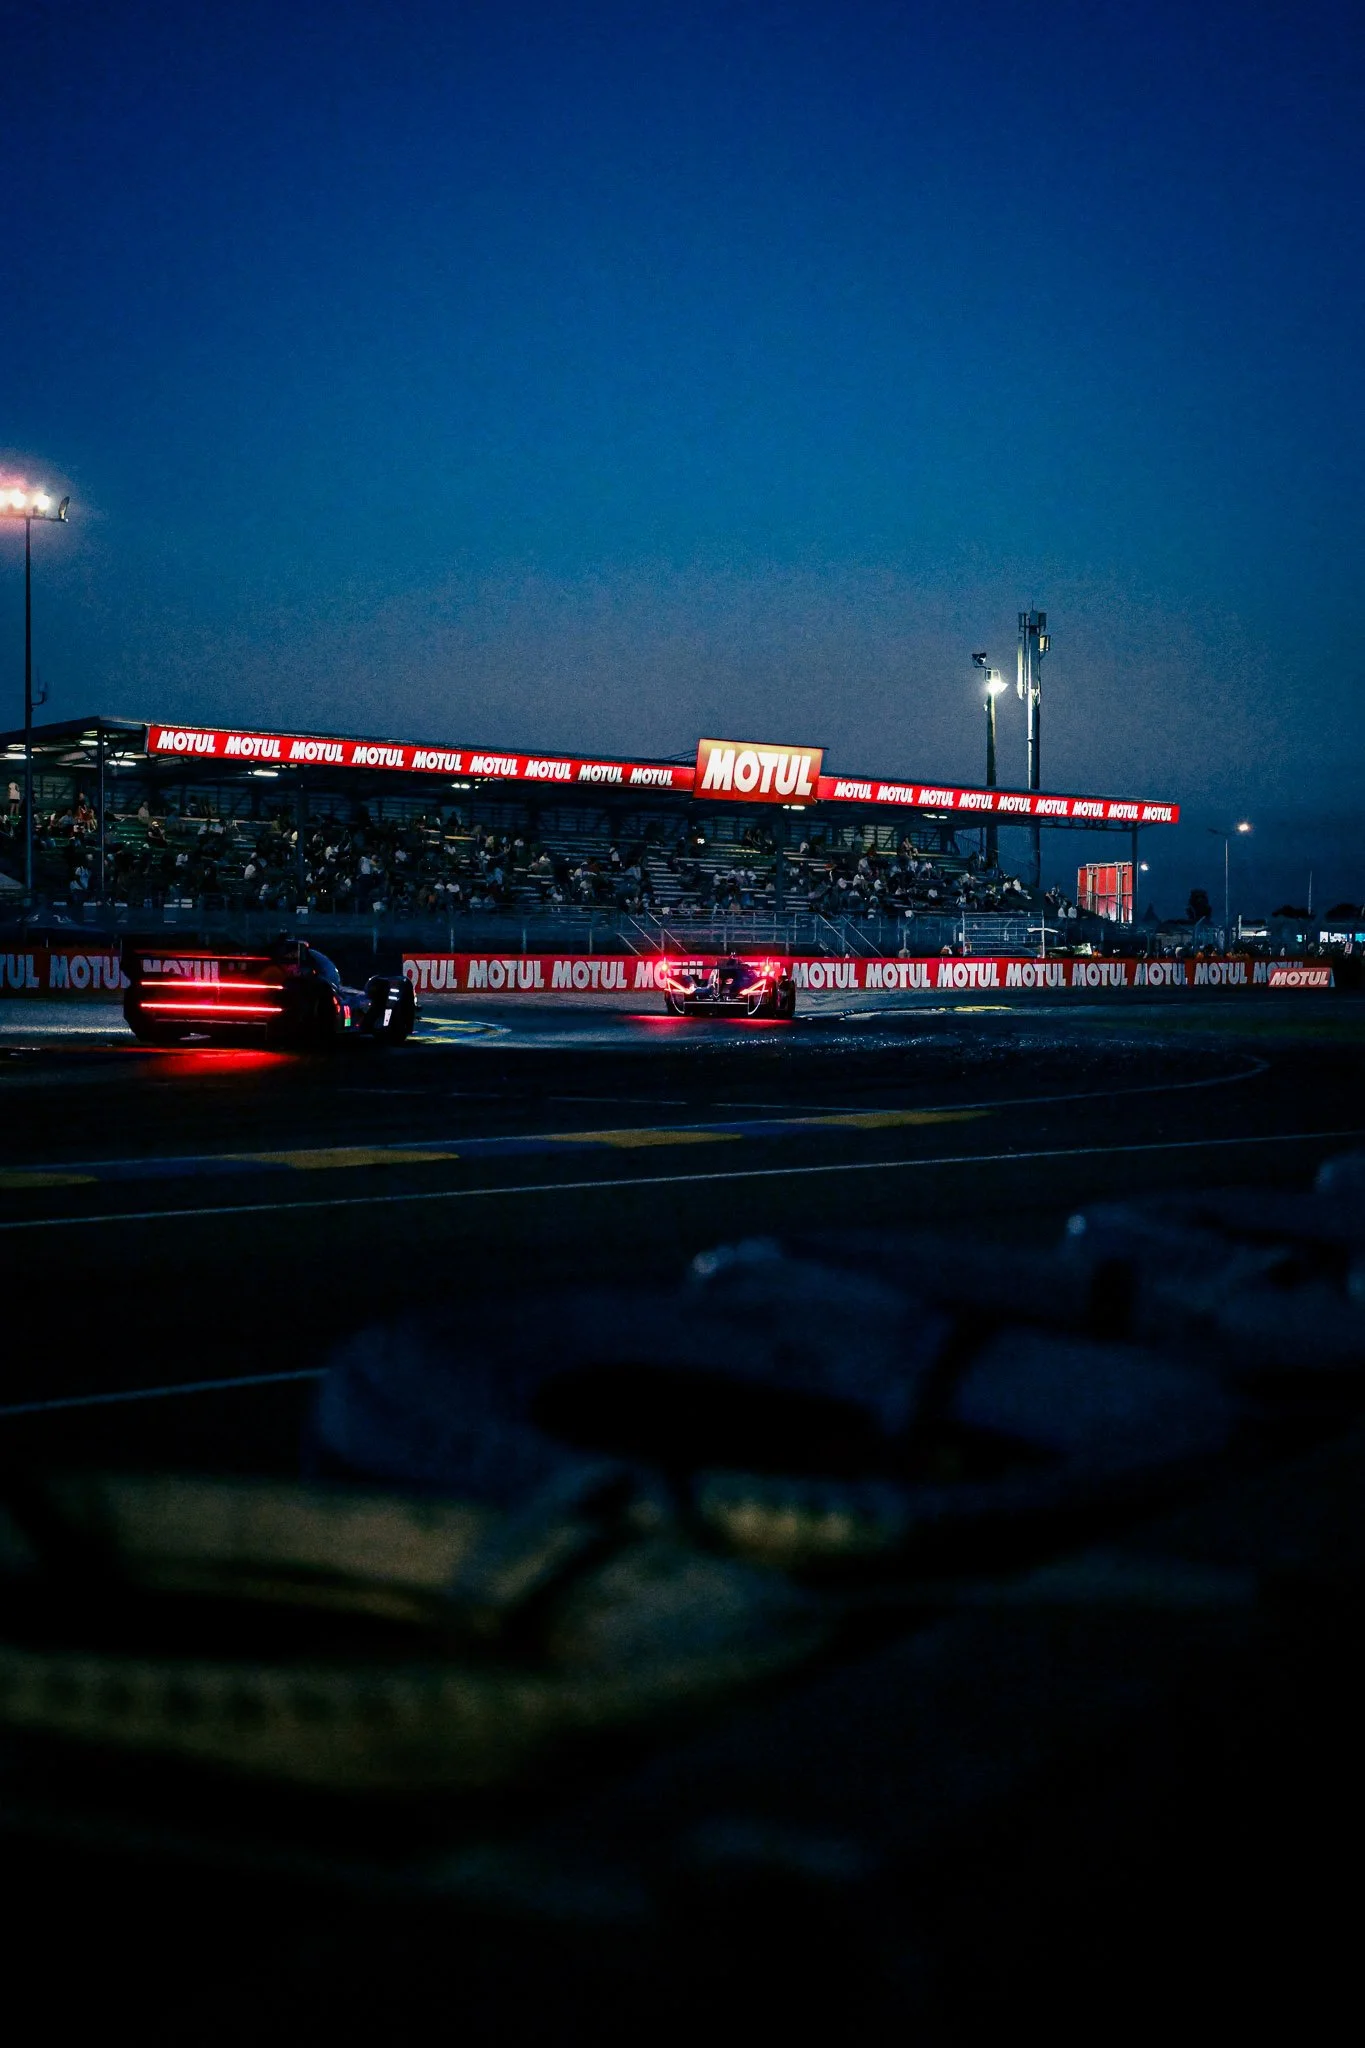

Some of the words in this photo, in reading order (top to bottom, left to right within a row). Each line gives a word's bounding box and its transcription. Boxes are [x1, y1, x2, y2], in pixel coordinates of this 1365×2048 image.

[157, 731, 215, 753] MOTUL
[225, 736, 280, 758] MOTUL
[289, 741, 343, 763] MOTUL
[352, 746, 404, 767] MOTUL
[412, 751, 461, 771] MOTUL
[470, 756, 517, 775] MOTUL
[525, 760, 571, 779] MOTUL
[578, 765, 622, 783] MOTUL
[630, 769, 672, 786] MOTUL
[701, 748, 813, 796] MOTUL
[834, 782, 871, 799] MOTUL
[877, 786, 913, 803] MOTUL
[918, 790, 953, 806] MOTUL
[959, 793, 993, 809] MOTUL
[998, 796, 1031, 812] MOTUL
[1036, 799, 1067, 814] MOTUL
[1072, 802, 1103, 817] MOTUL
[1108, 804, 1138, 819] MOTUL
[1142, 806, 1172, 821] MOTUL
[467, 960, 545, 989] MOTUL
[552, 961, 628, 989] MOTUL
[791, 962, 859, 989] MOTUL
[866, 963, 931, 989] MOTUL
[937, 963, 1000, 988] MOTUL
[1006, 963, 1066, 988] MOTUL
[1072, 963, 1128, 987] MOTUL
[1134, 963, 1188, 986] MOTUL
[1194, 963, 1248, 985] MOTUL
[1269, 971, 1329, 986] MOTUL
